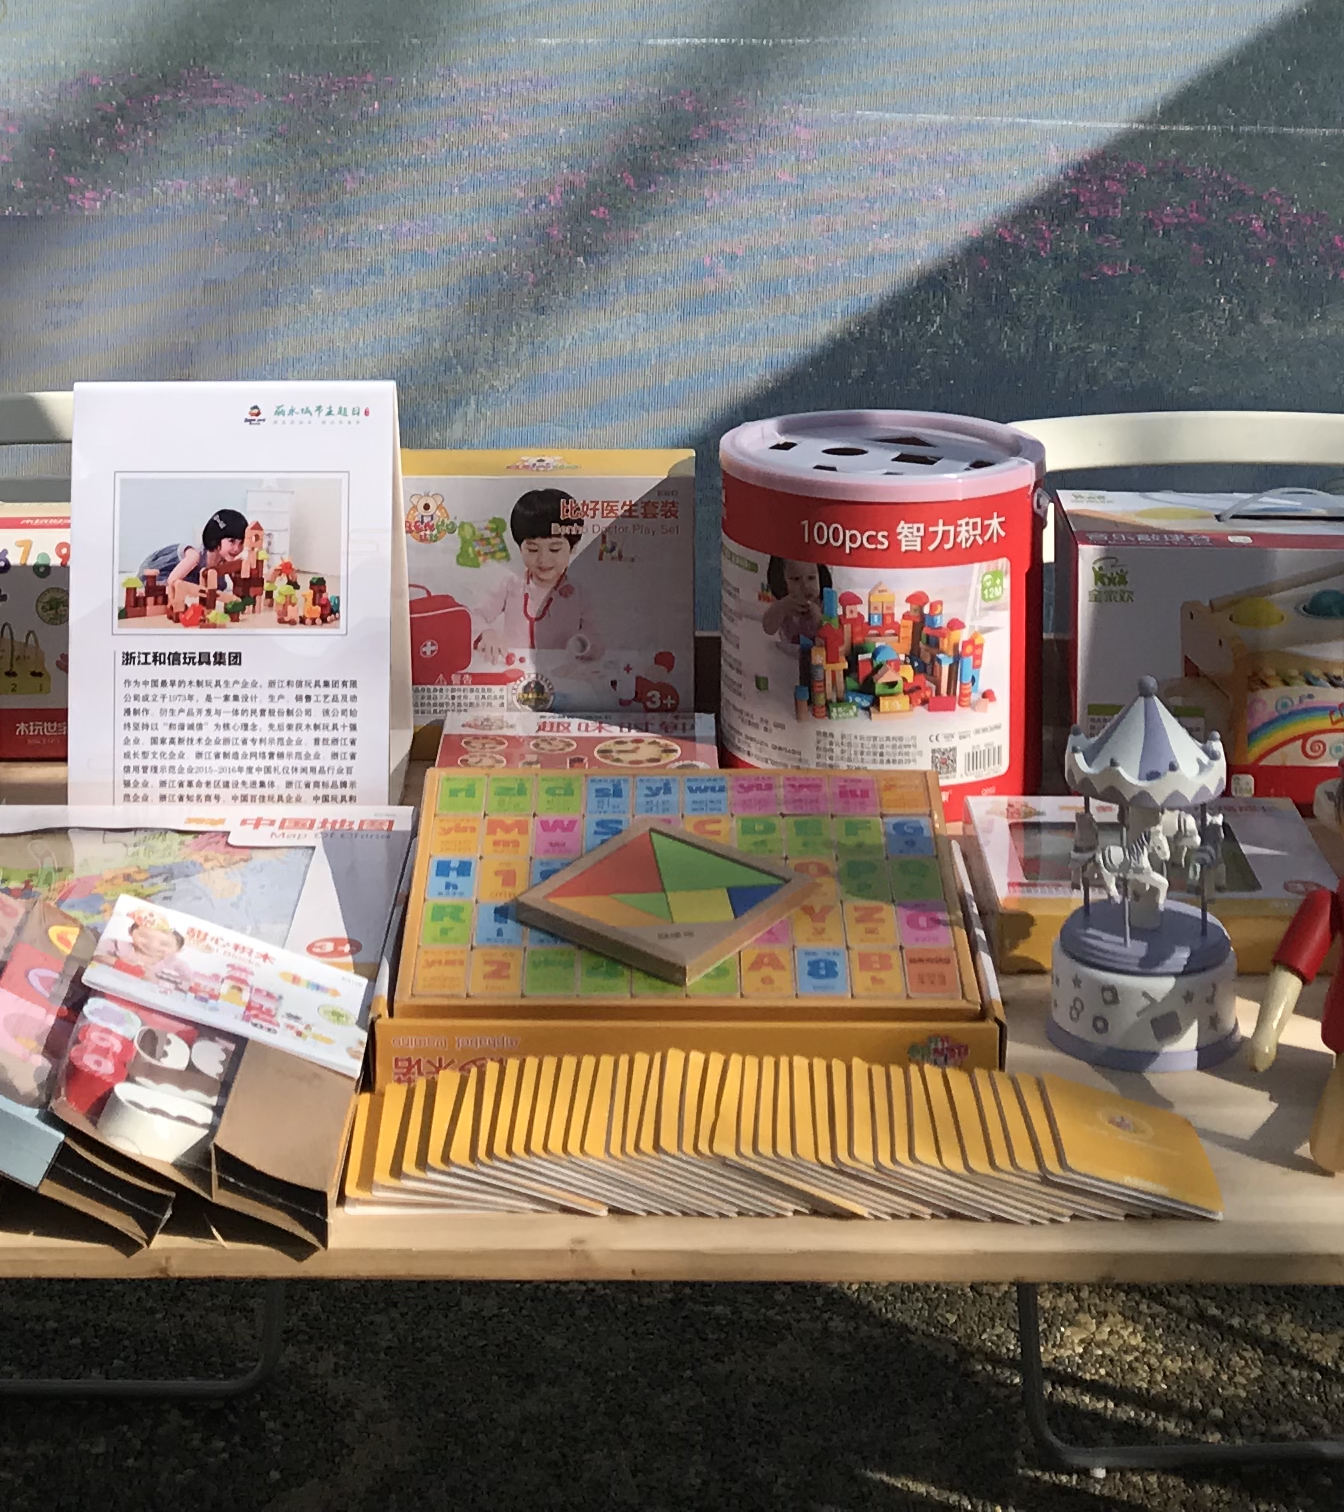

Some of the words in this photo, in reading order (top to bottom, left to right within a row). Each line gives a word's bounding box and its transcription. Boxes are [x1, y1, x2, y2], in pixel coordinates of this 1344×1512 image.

[559, 499, 680, 520] 比好医生套装
[592, 523, 630, 535] Doctor
[632, 523, 656, 536] Play
[661, 523, 680, 535] Set
[801, 519, 890, 553] 100pcs
[896, 512, 1007, 553] 智力积木
[15, 539, 33, 566] 7
[55, 541, 70, 567] 9
[121, 651, 243, 666] 浙江和信玩具集团
[646, 690, 675, 708] 3+
[239, 816, 395, 832] 中国地图
[487, 819, 528, 835] M
[540, 819, 578, 832] W
[740, 818, 776, 835] D
[794, 818, 822, 836] E
[845, 819, 872, 836] F
[435, 860, 472, 877] H
[431, 904, 465, 922] R
[800, 905, 834, 923] Y
[853, 905, 885, 923] Z
[748, 952, 787, 971] A
[858, 952, 893, 972] B
